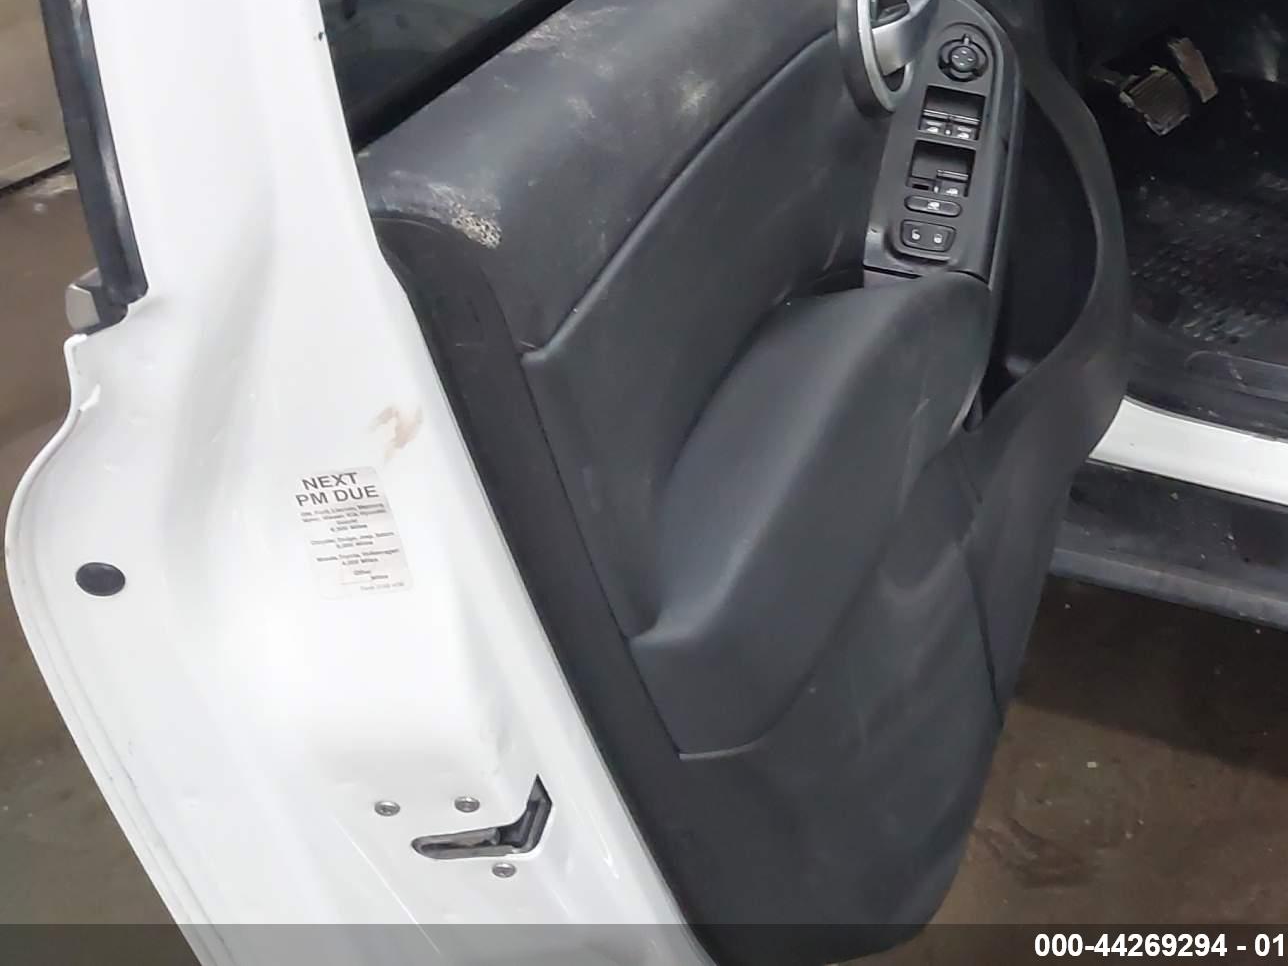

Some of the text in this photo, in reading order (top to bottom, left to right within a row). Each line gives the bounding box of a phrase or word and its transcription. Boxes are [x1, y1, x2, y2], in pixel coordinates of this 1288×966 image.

[302, 472, 358, 490] NEXT
[296, 485, 380, 506] PM DUE
